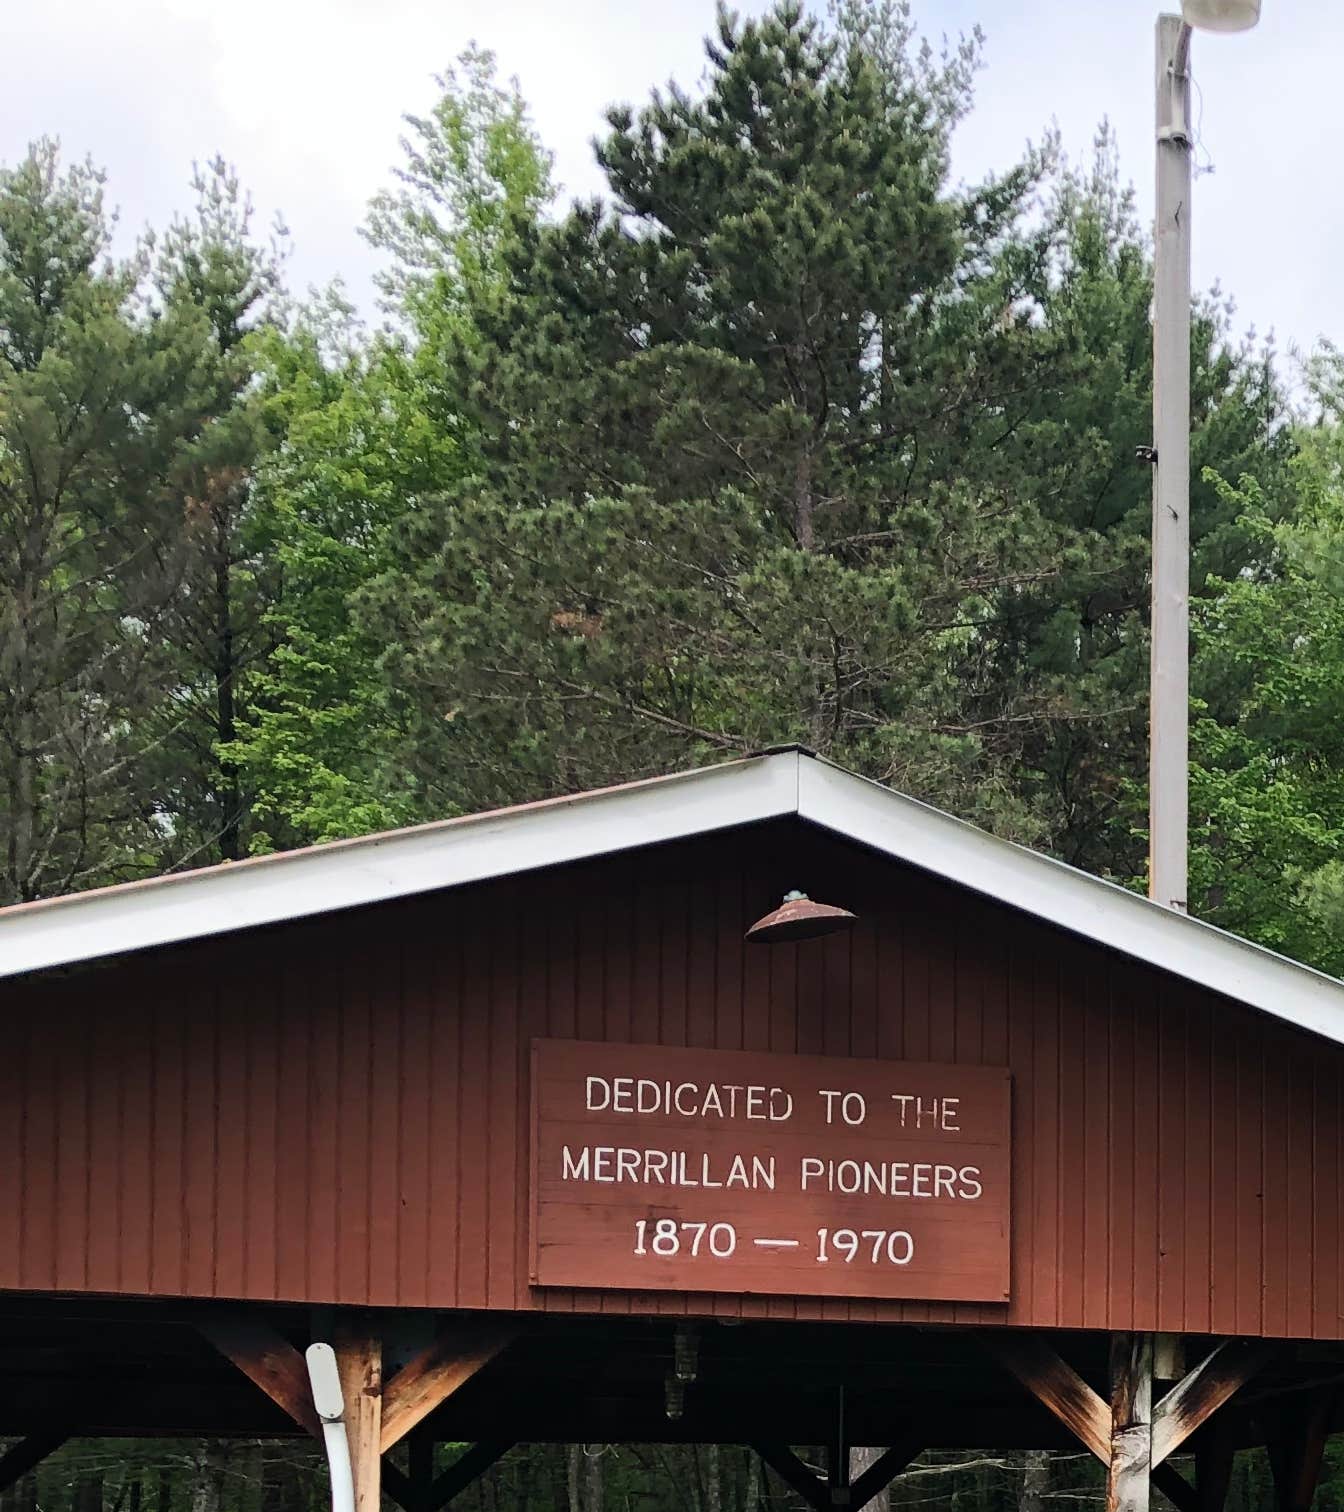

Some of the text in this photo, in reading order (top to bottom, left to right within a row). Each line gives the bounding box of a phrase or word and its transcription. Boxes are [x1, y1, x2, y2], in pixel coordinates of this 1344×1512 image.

[585, 1076, 961, 1131] DEDICATED TO THE
[561, 1145, 983, 1200] MERRILLAN PIONEERS
[633, 1218, 737, 1257] 1870
[815, 1227, 915, 1266] 1970
